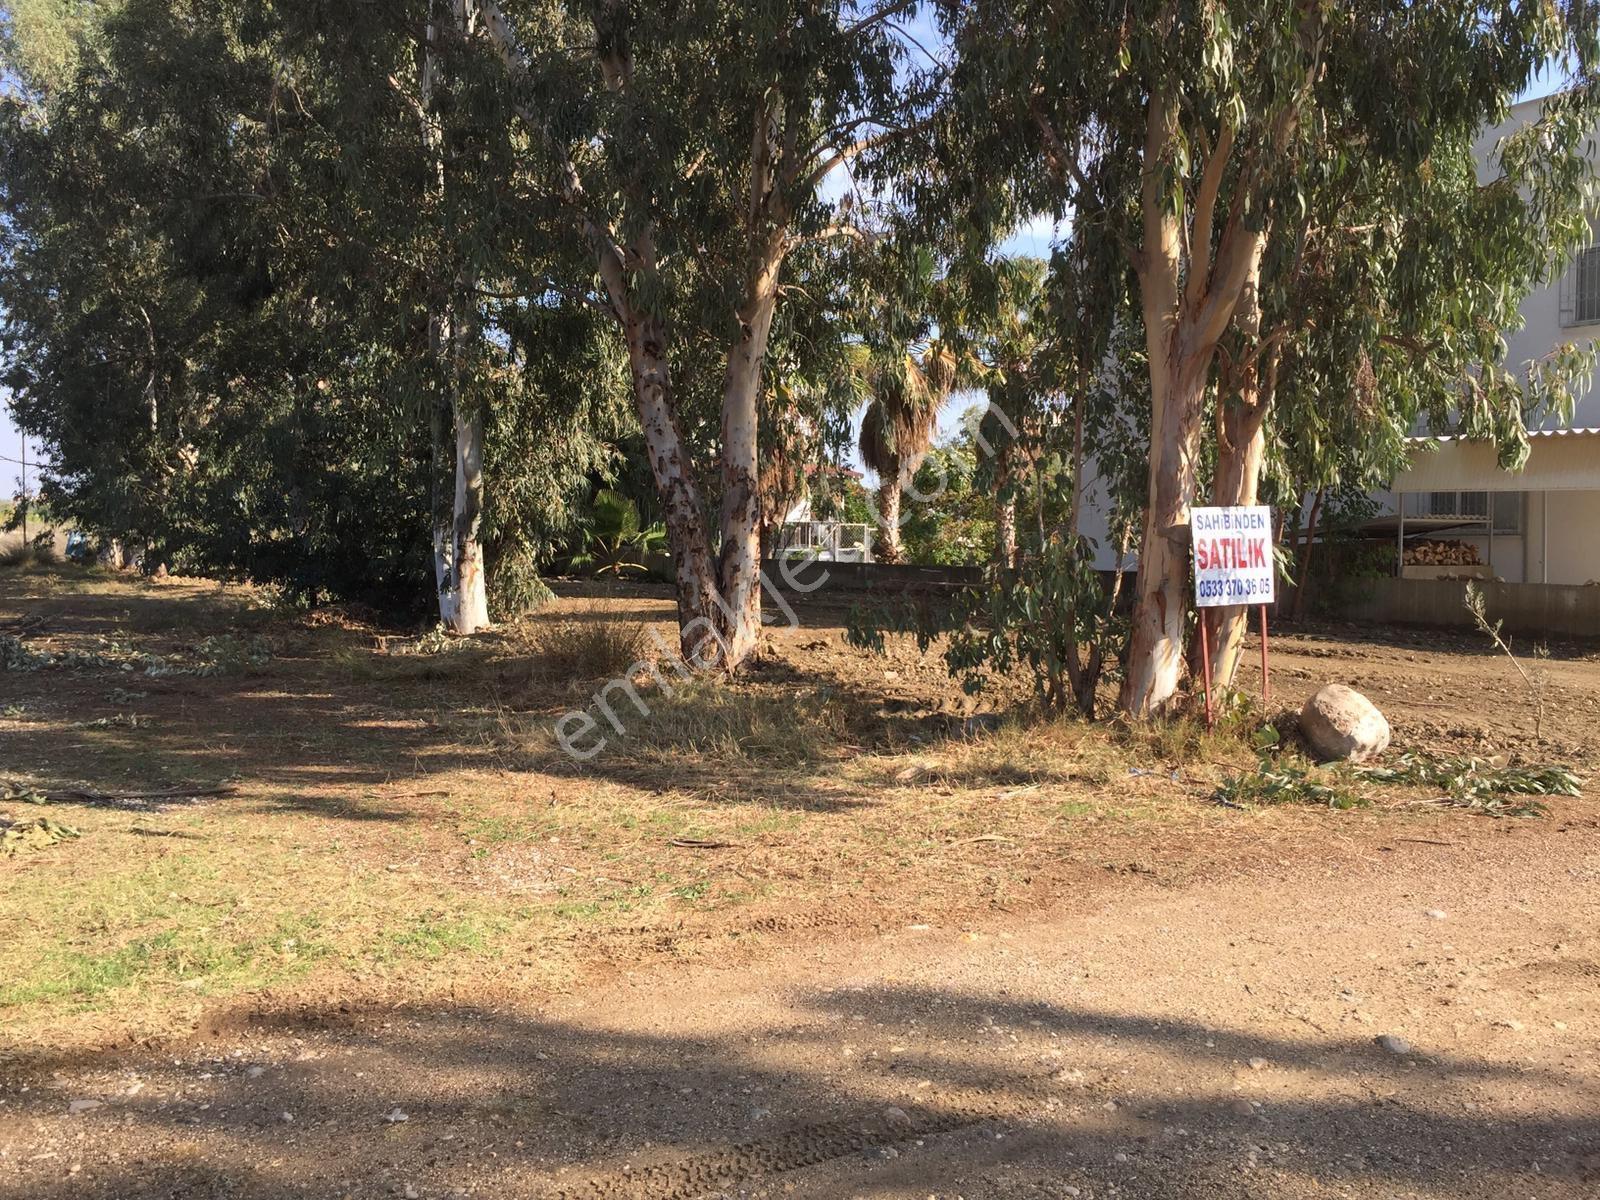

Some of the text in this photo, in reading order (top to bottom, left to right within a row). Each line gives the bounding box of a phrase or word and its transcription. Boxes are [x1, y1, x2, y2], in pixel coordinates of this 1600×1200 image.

[1197, 537, 1266, 570] SATILIK
[1199, 580, 1224, 598] 0533
[1226, 579, 1243, 596] 370
[1260, 578, 1270, 594] 05
